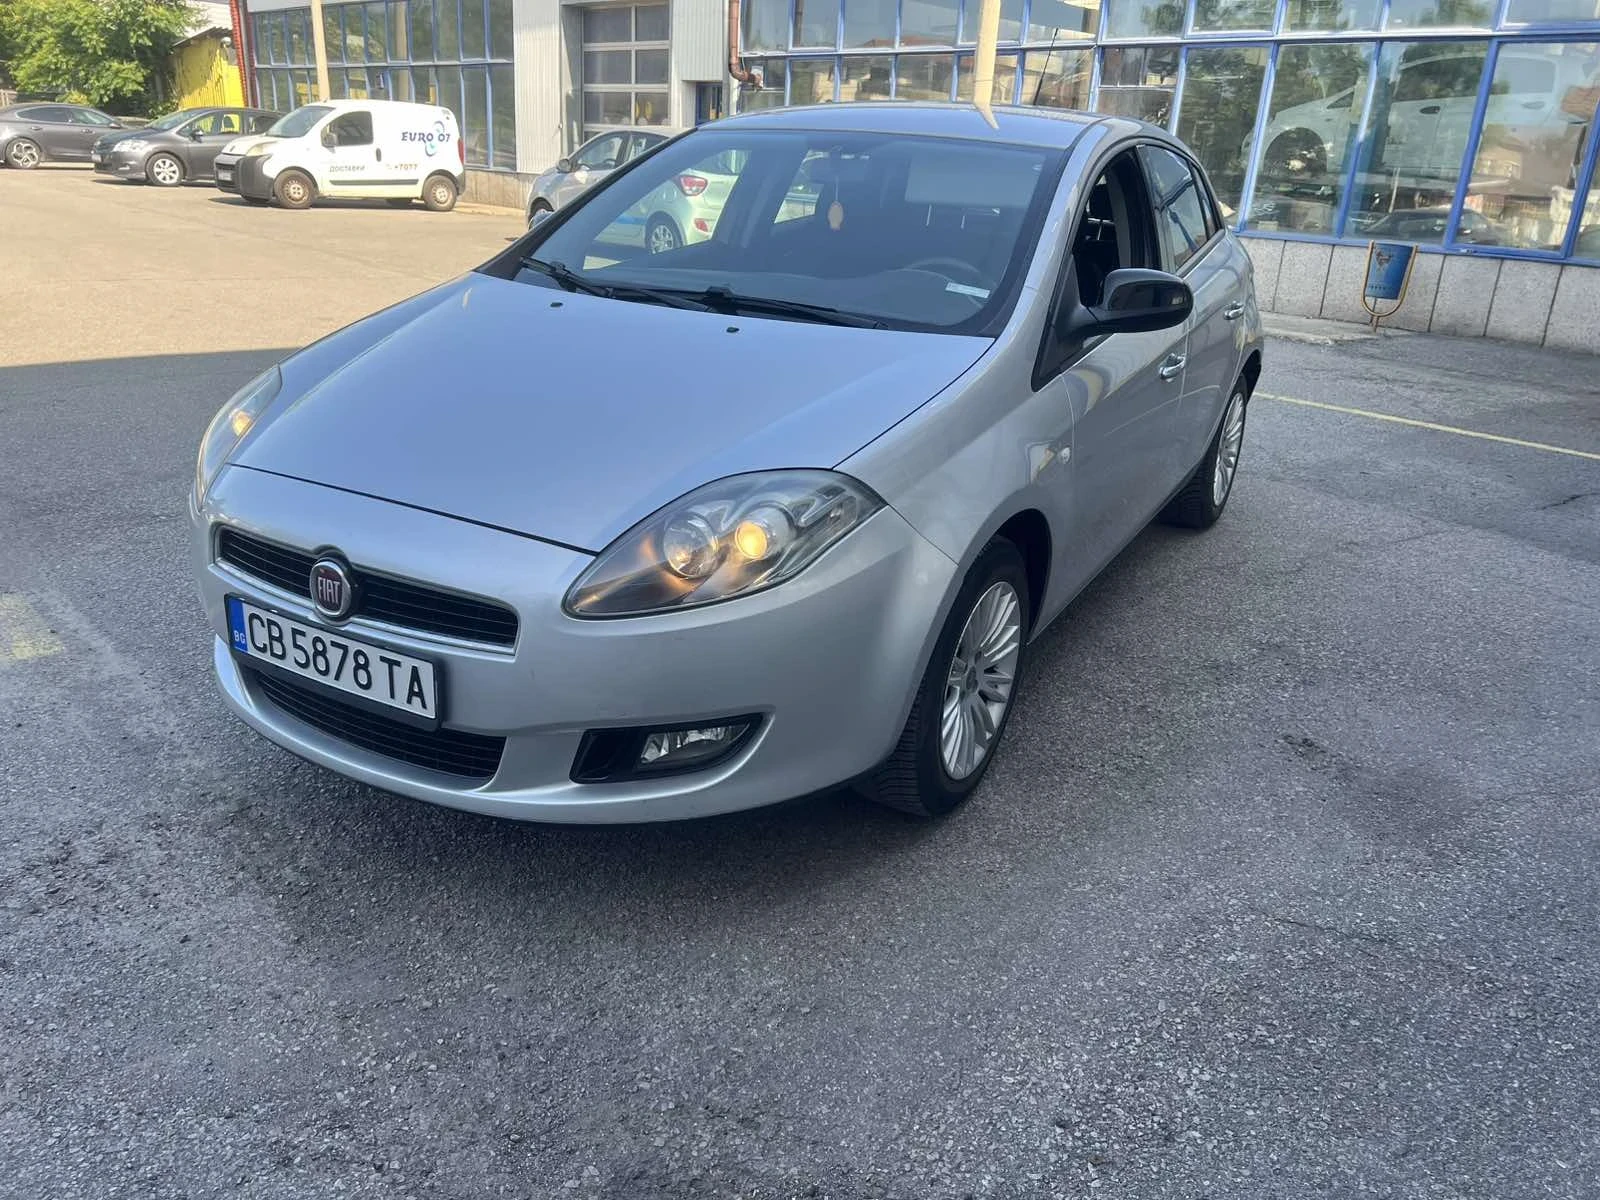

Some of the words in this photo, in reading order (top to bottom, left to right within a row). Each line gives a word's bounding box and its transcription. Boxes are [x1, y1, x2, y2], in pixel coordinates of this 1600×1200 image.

[401, 131, 434, 143] EURO
[437, 132, 451, 143] 07
[317, 576, 341, 604] FIAT
[233, 629, 246, 644] BG
